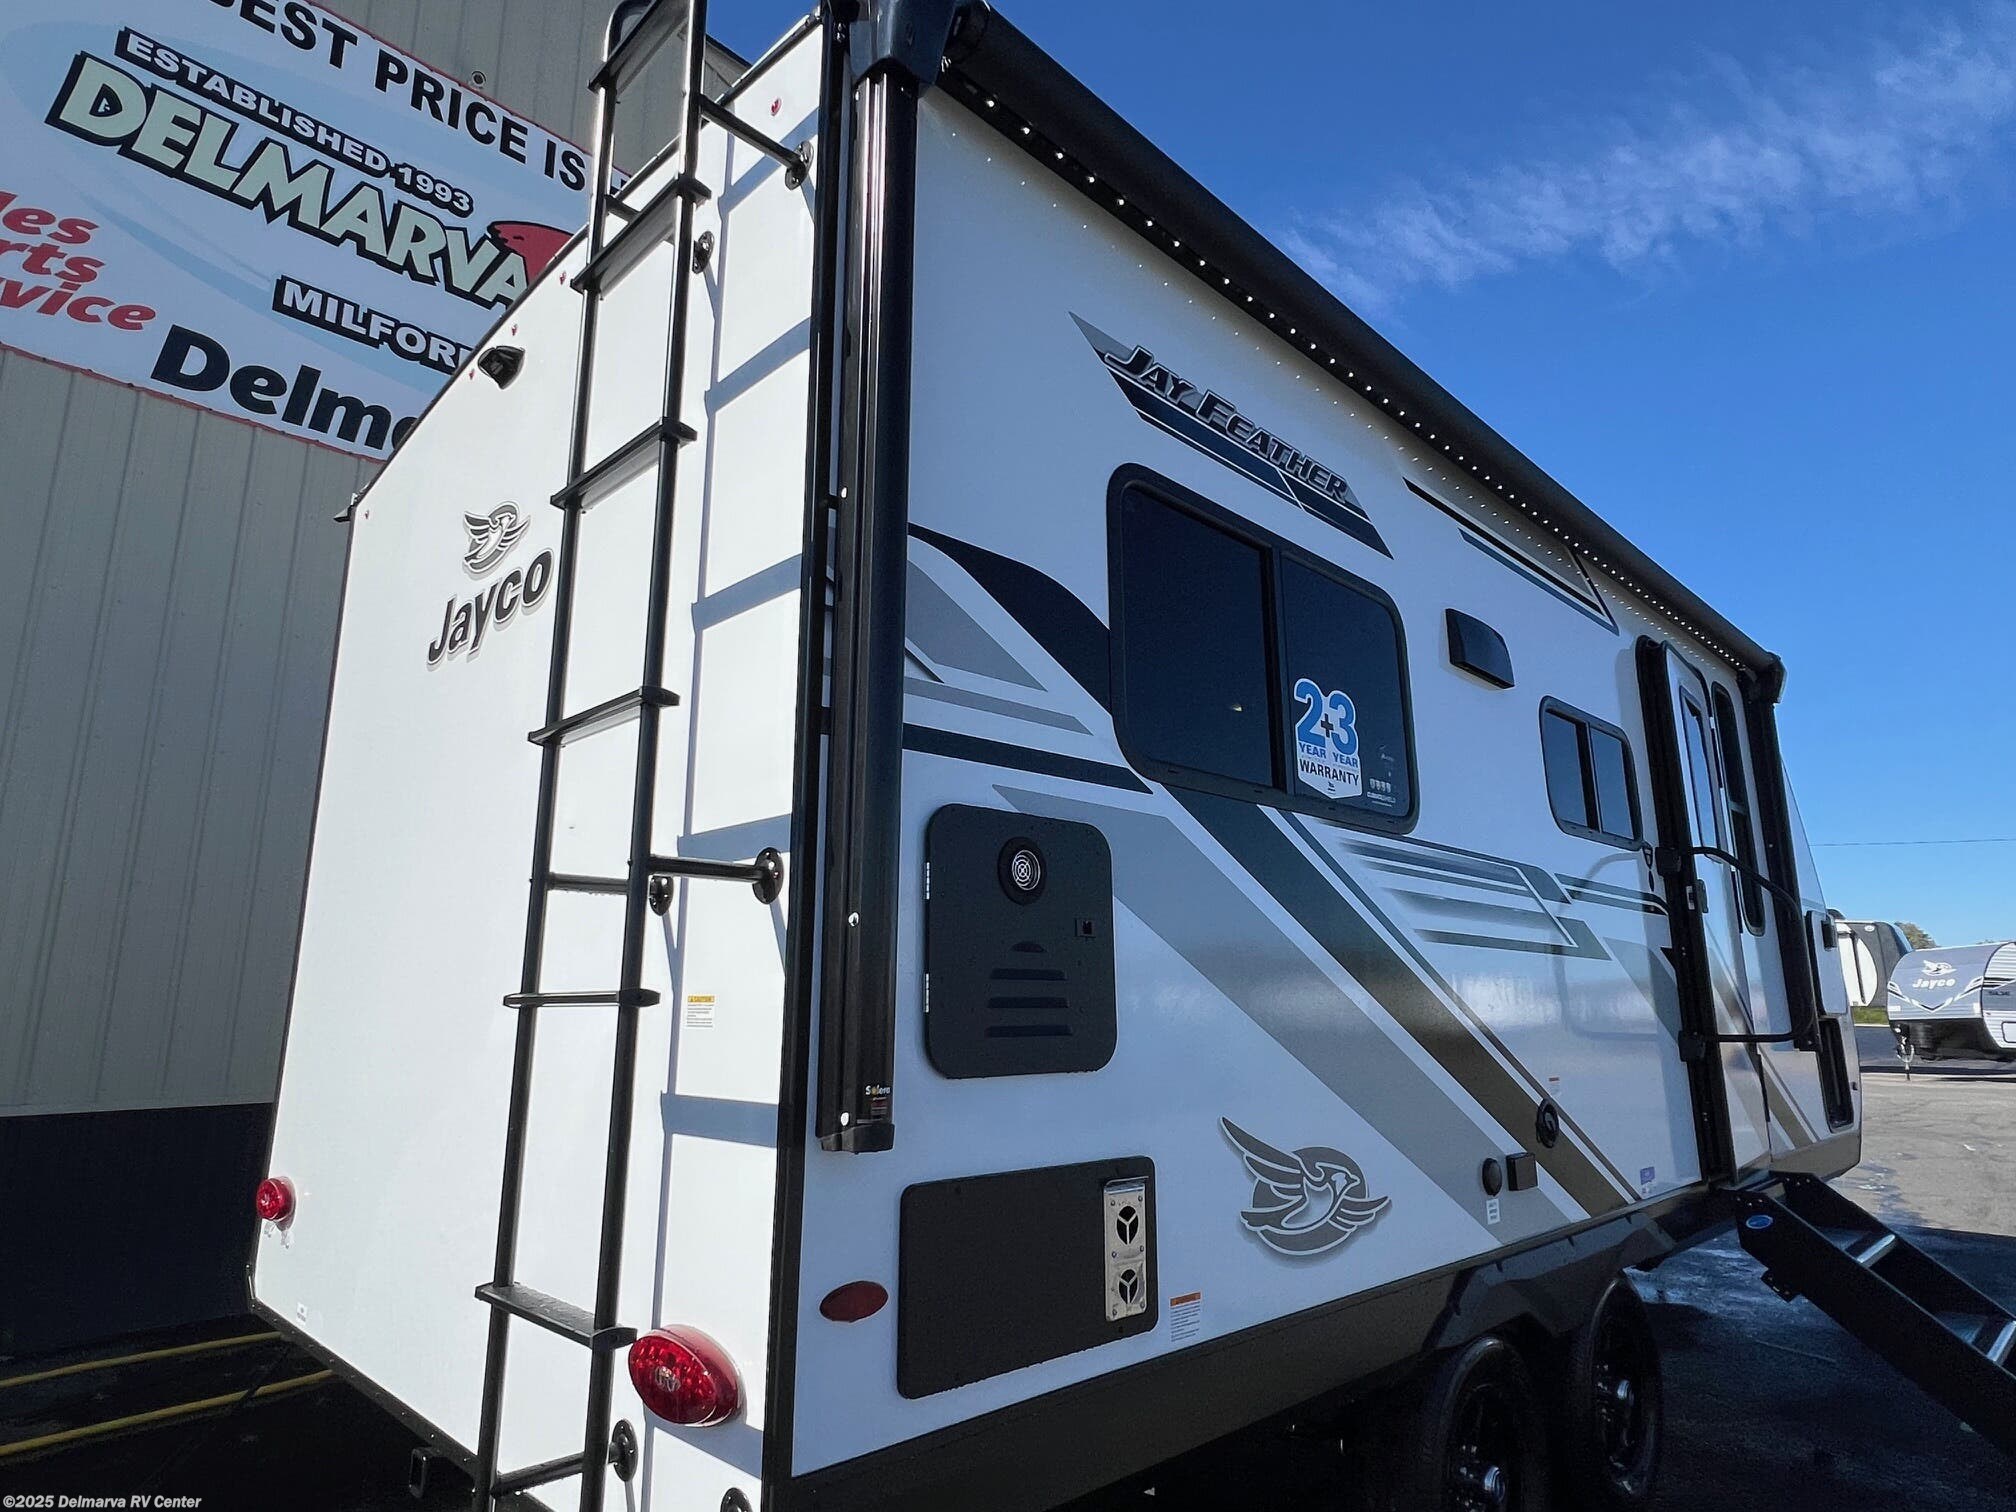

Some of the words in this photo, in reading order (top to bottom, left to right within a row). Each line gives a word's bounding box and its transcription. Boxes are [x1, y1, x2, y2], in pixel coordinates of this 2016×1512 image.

[127, 39, 388, 172] ESTABLISHED
[397, 165, 472, 213] 1993
[206, 0, 358, 70] EST
[374, 48, 528, 164] PRICE
[544, 139, 586, 191] IS
[46, 51, 529, 310] DELMARVA
[427, 549, 554, 664] Jayco
[1299, 741, 1327, 759] YEAR
[1332, 751, 1359, 769] YEAR
[1299, 758, 1360, 786] WARRANTY
[1913, 978, 1956, 989] Jayco
